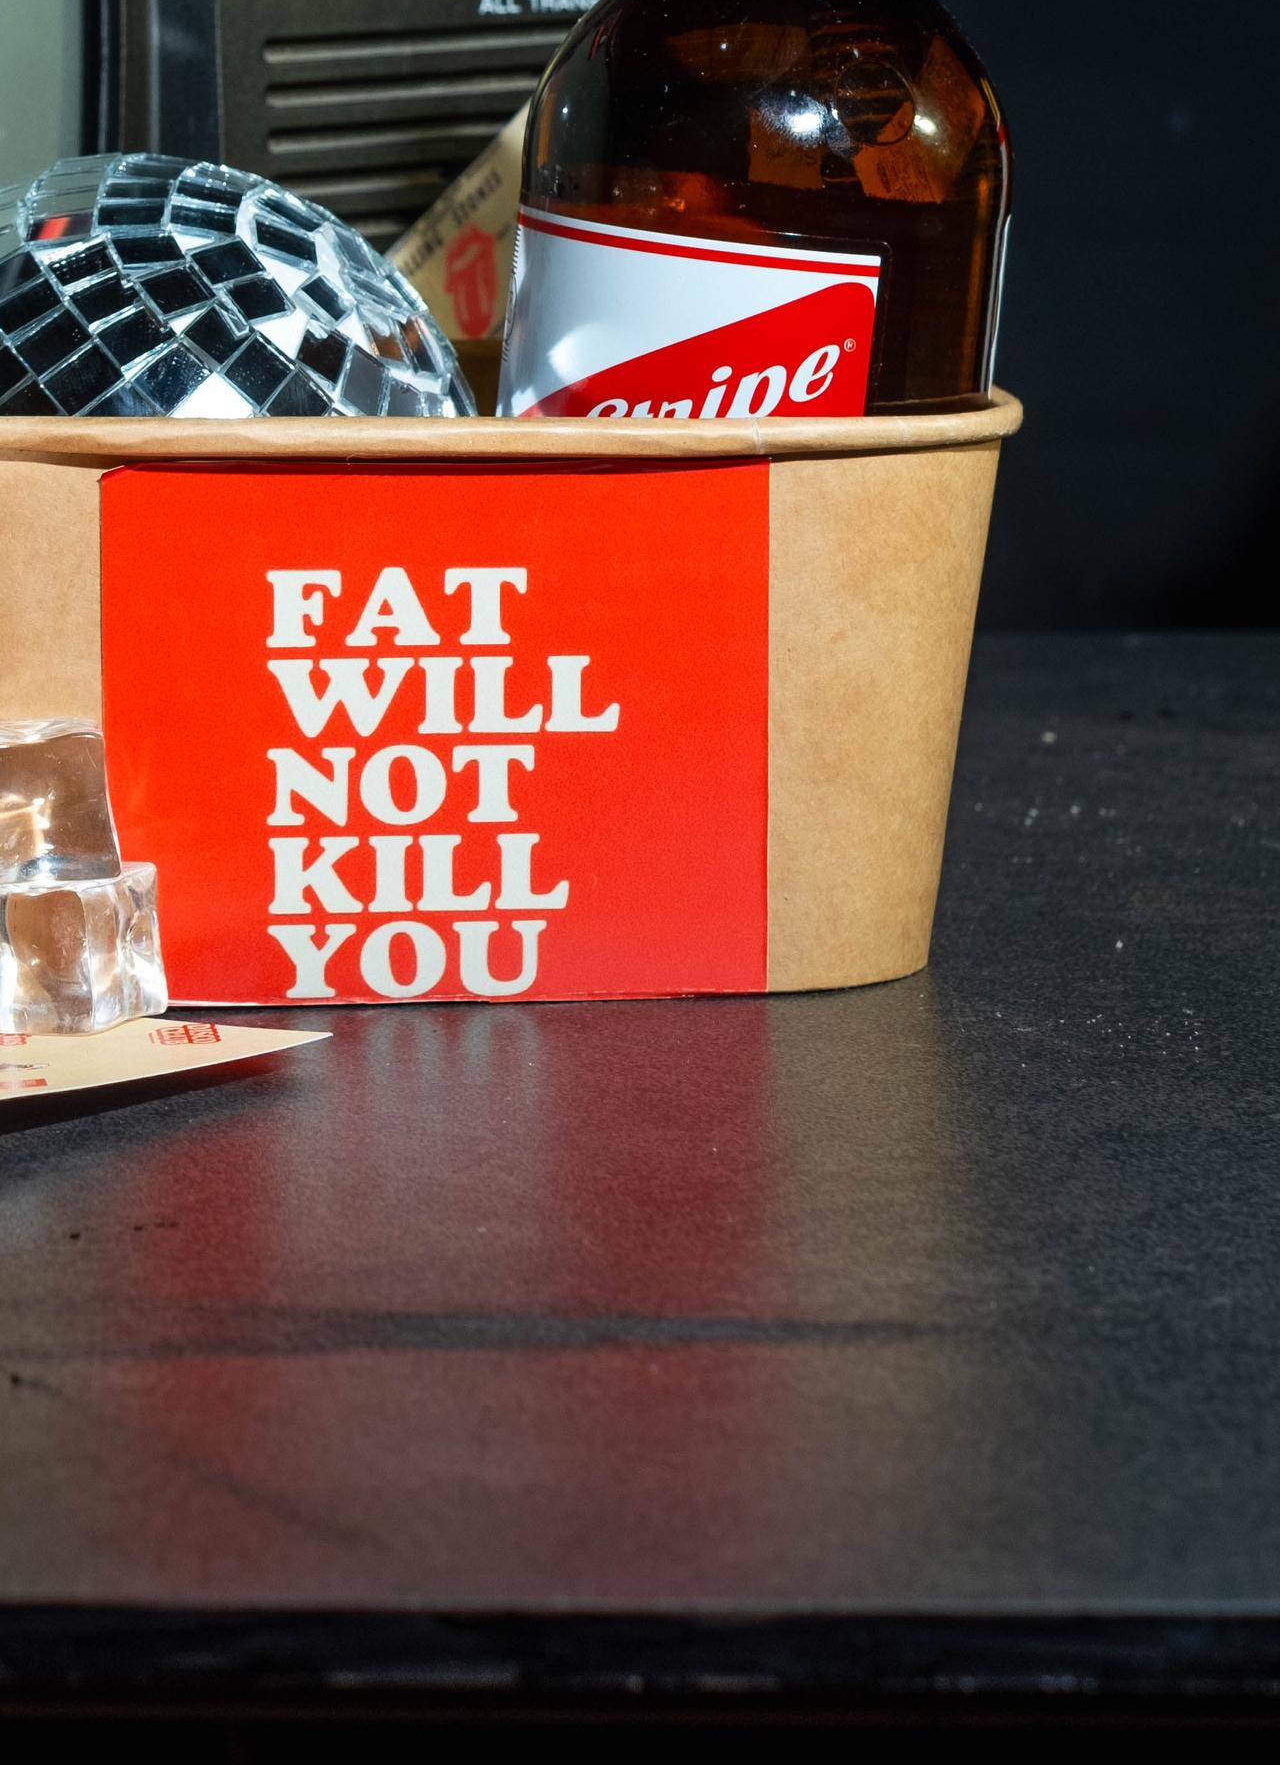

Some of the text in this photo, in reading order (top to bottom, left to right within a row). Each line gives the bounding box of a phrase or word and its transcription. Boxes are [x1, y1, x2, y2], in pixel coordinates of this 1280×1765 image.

[266, 567, 527, 648] FAT
[266, 655, 620, 738] WILL
[266, 745, 535, 826] NOT
[268, 833, 570, 915] KILL
[267, 920, 547, 998] YOU
